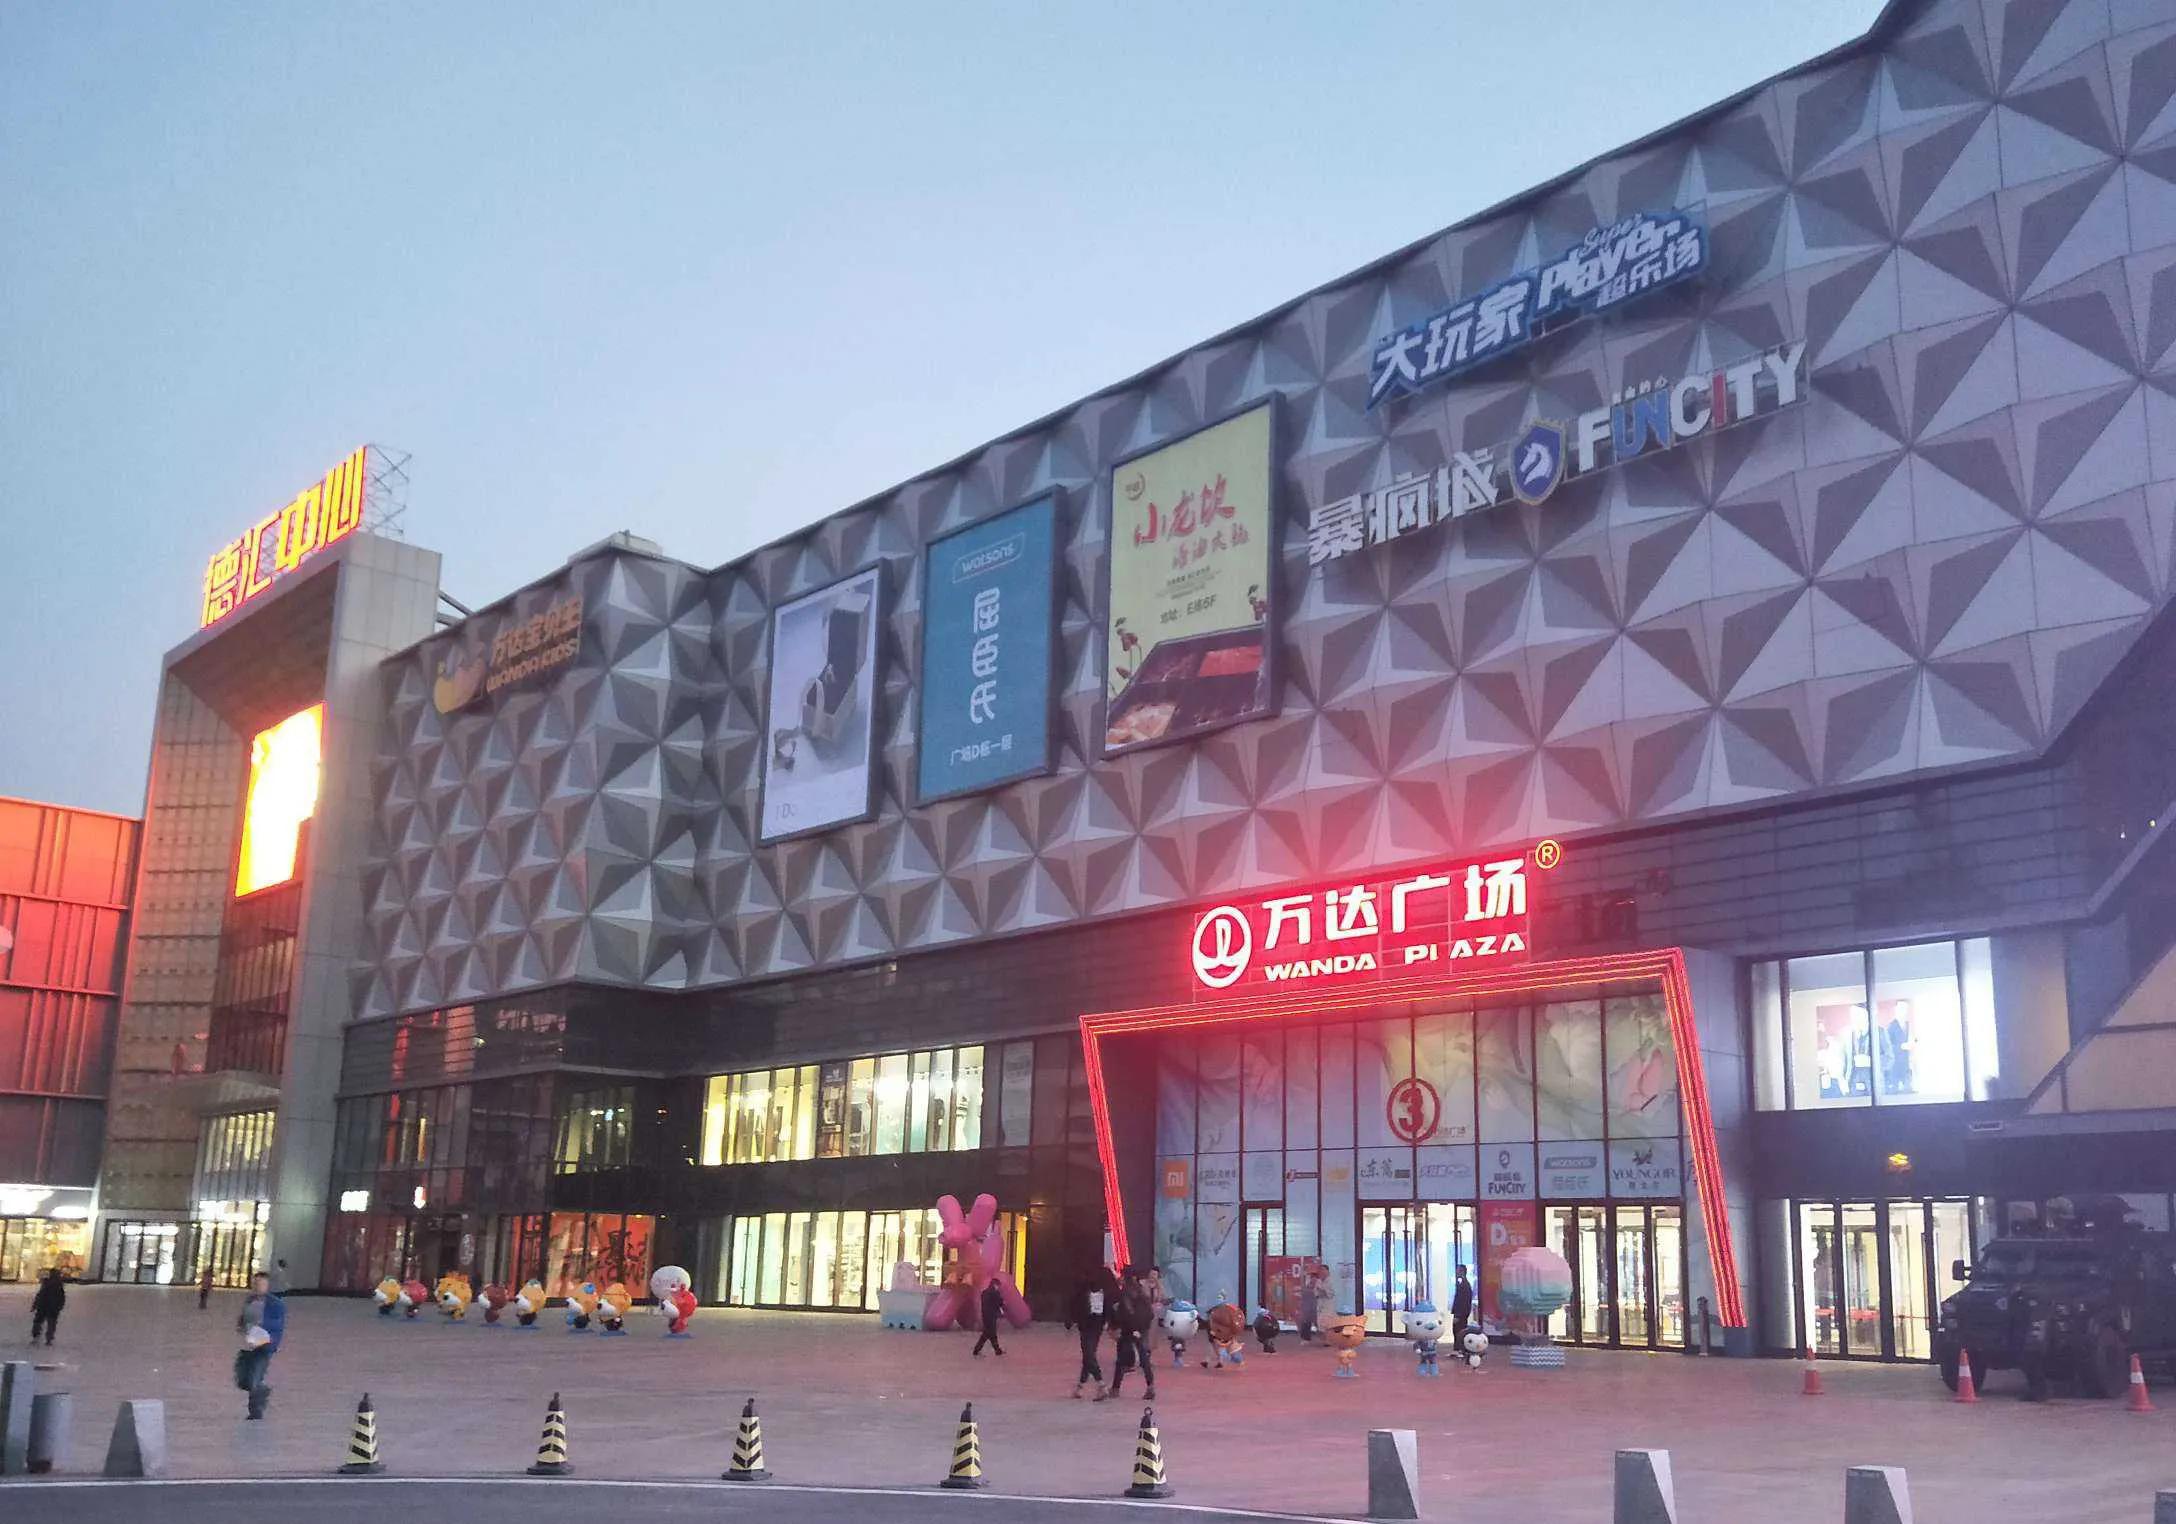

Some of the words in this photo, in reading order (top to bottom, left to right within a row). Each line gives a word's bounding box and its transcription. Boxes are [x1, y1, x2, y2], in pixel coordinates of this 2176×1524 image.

[1372, 280, 1529, 398] 大玩家
[1578, 341, 1807, 472] FUNCITY
[201, 445, 367, 630] 德汇中心
[1308, 448, 1499, 566] 暴疯城
[970, 587, 1000, 724] 屈臣氏
[1262, 858, 1526, 951] 万达广场
[1264, 953, 1376, 982] WANDA
[1398, 1086, 1424, 1132] 3
